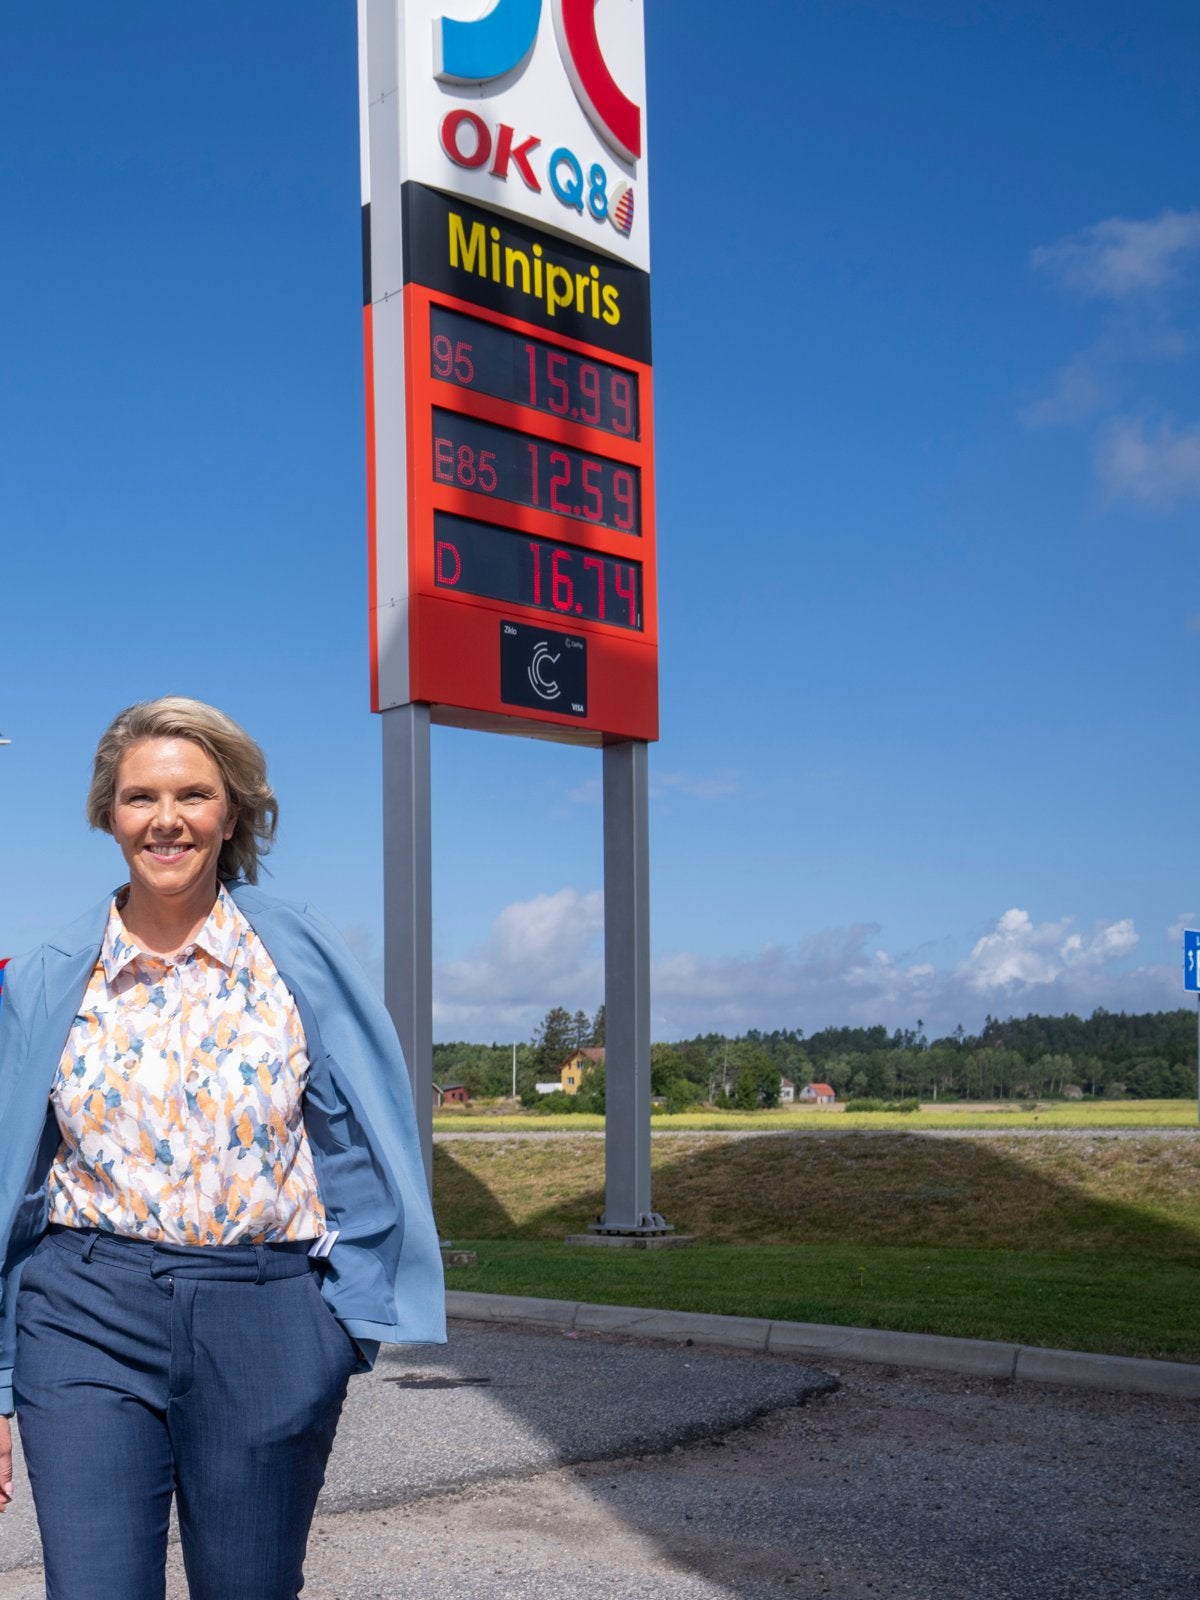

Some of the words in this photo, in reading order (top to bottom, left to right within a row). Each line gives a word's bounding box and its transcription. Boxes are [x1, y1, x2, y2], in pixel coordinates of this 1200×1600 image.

[448, 212, 620, 325] Minipris
[432, 335, 475, 384] 95
[525, 344, 632, 434] 15.99
[434, 437, 497, 492] E85
[528, 443, 634, 530] 12.59
[436, 541, 461, 585] D
[529, 543, 636, 626] 16.74
[571, 703, 584, 712] VISA
